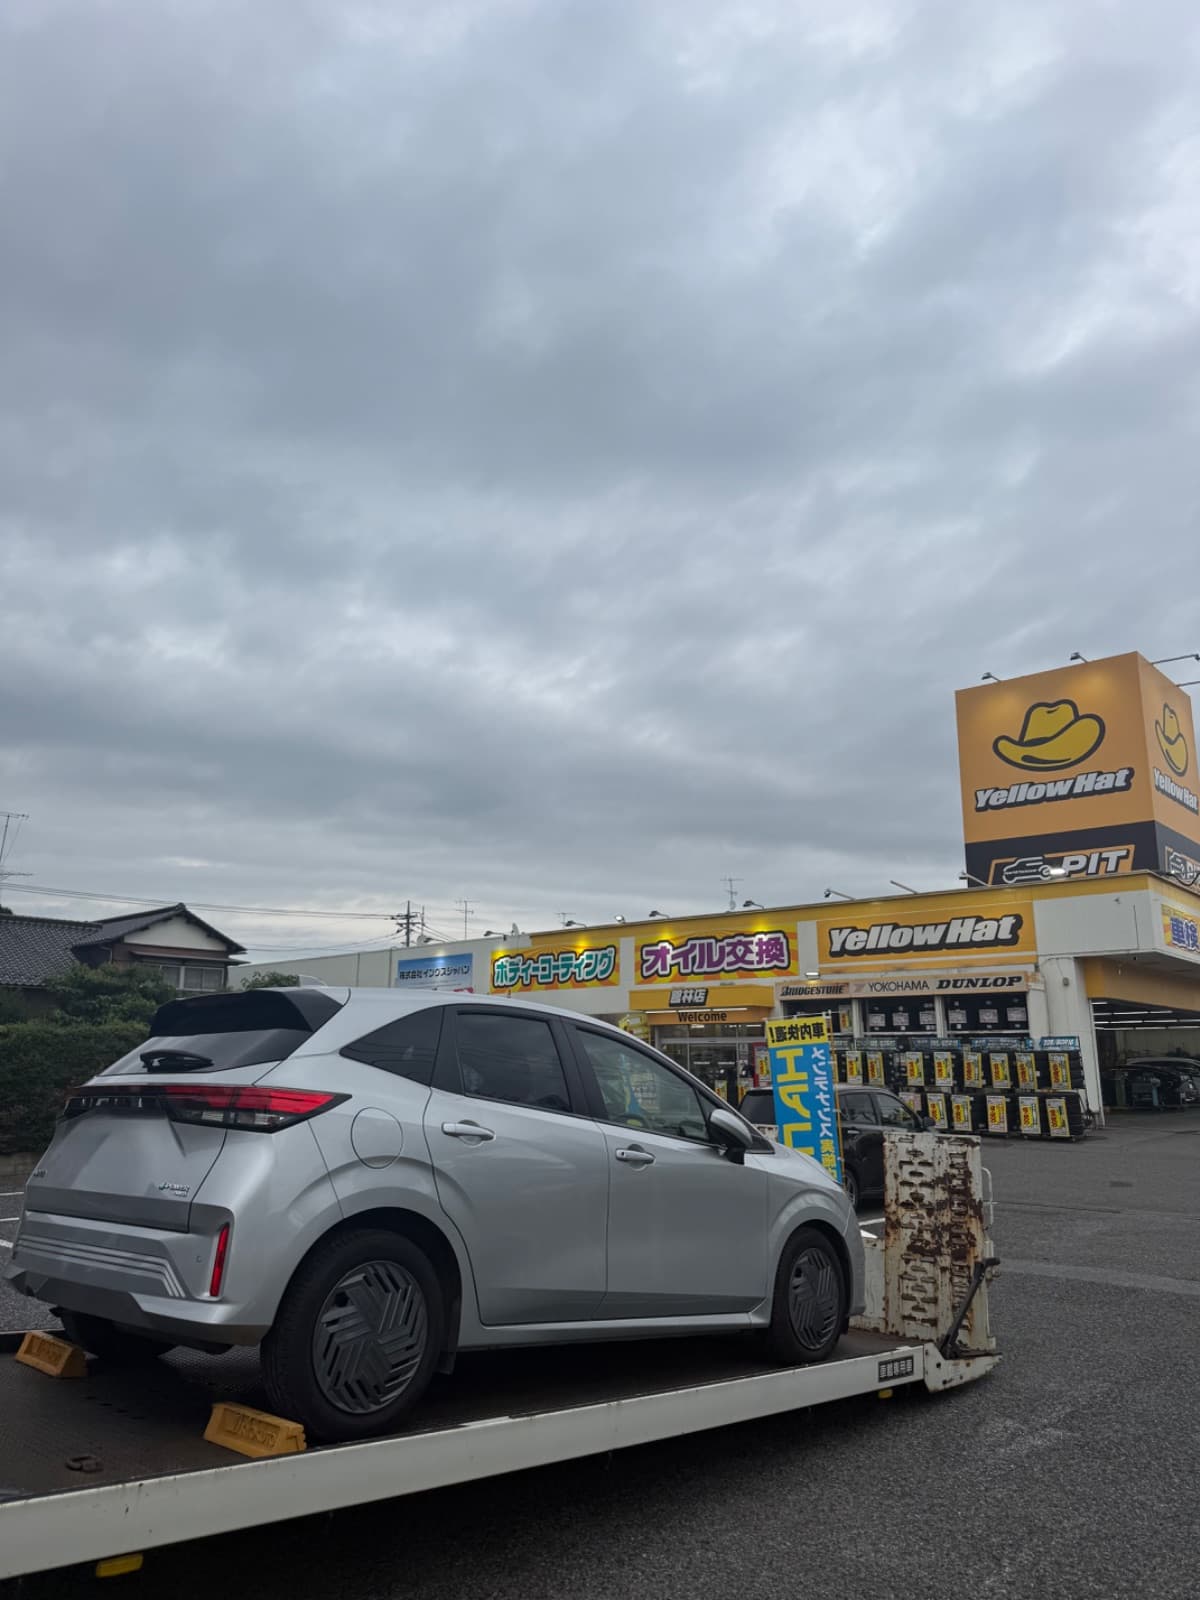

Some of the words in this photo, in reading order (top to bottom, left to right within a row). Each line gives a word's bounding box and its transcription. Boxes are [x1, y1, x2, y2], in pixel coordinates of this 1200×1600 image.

[1061, 849, 1129, 877] PIT
[641, 930, 790, 979] オイル交換
[492, 944, 616, 989] ボディーコーティング
[868, 980, 930, 993] YOKOHAMA
[936, 976, 1022, 990] DUNLOP
[678, 1011, 727, 1023] Welcome
